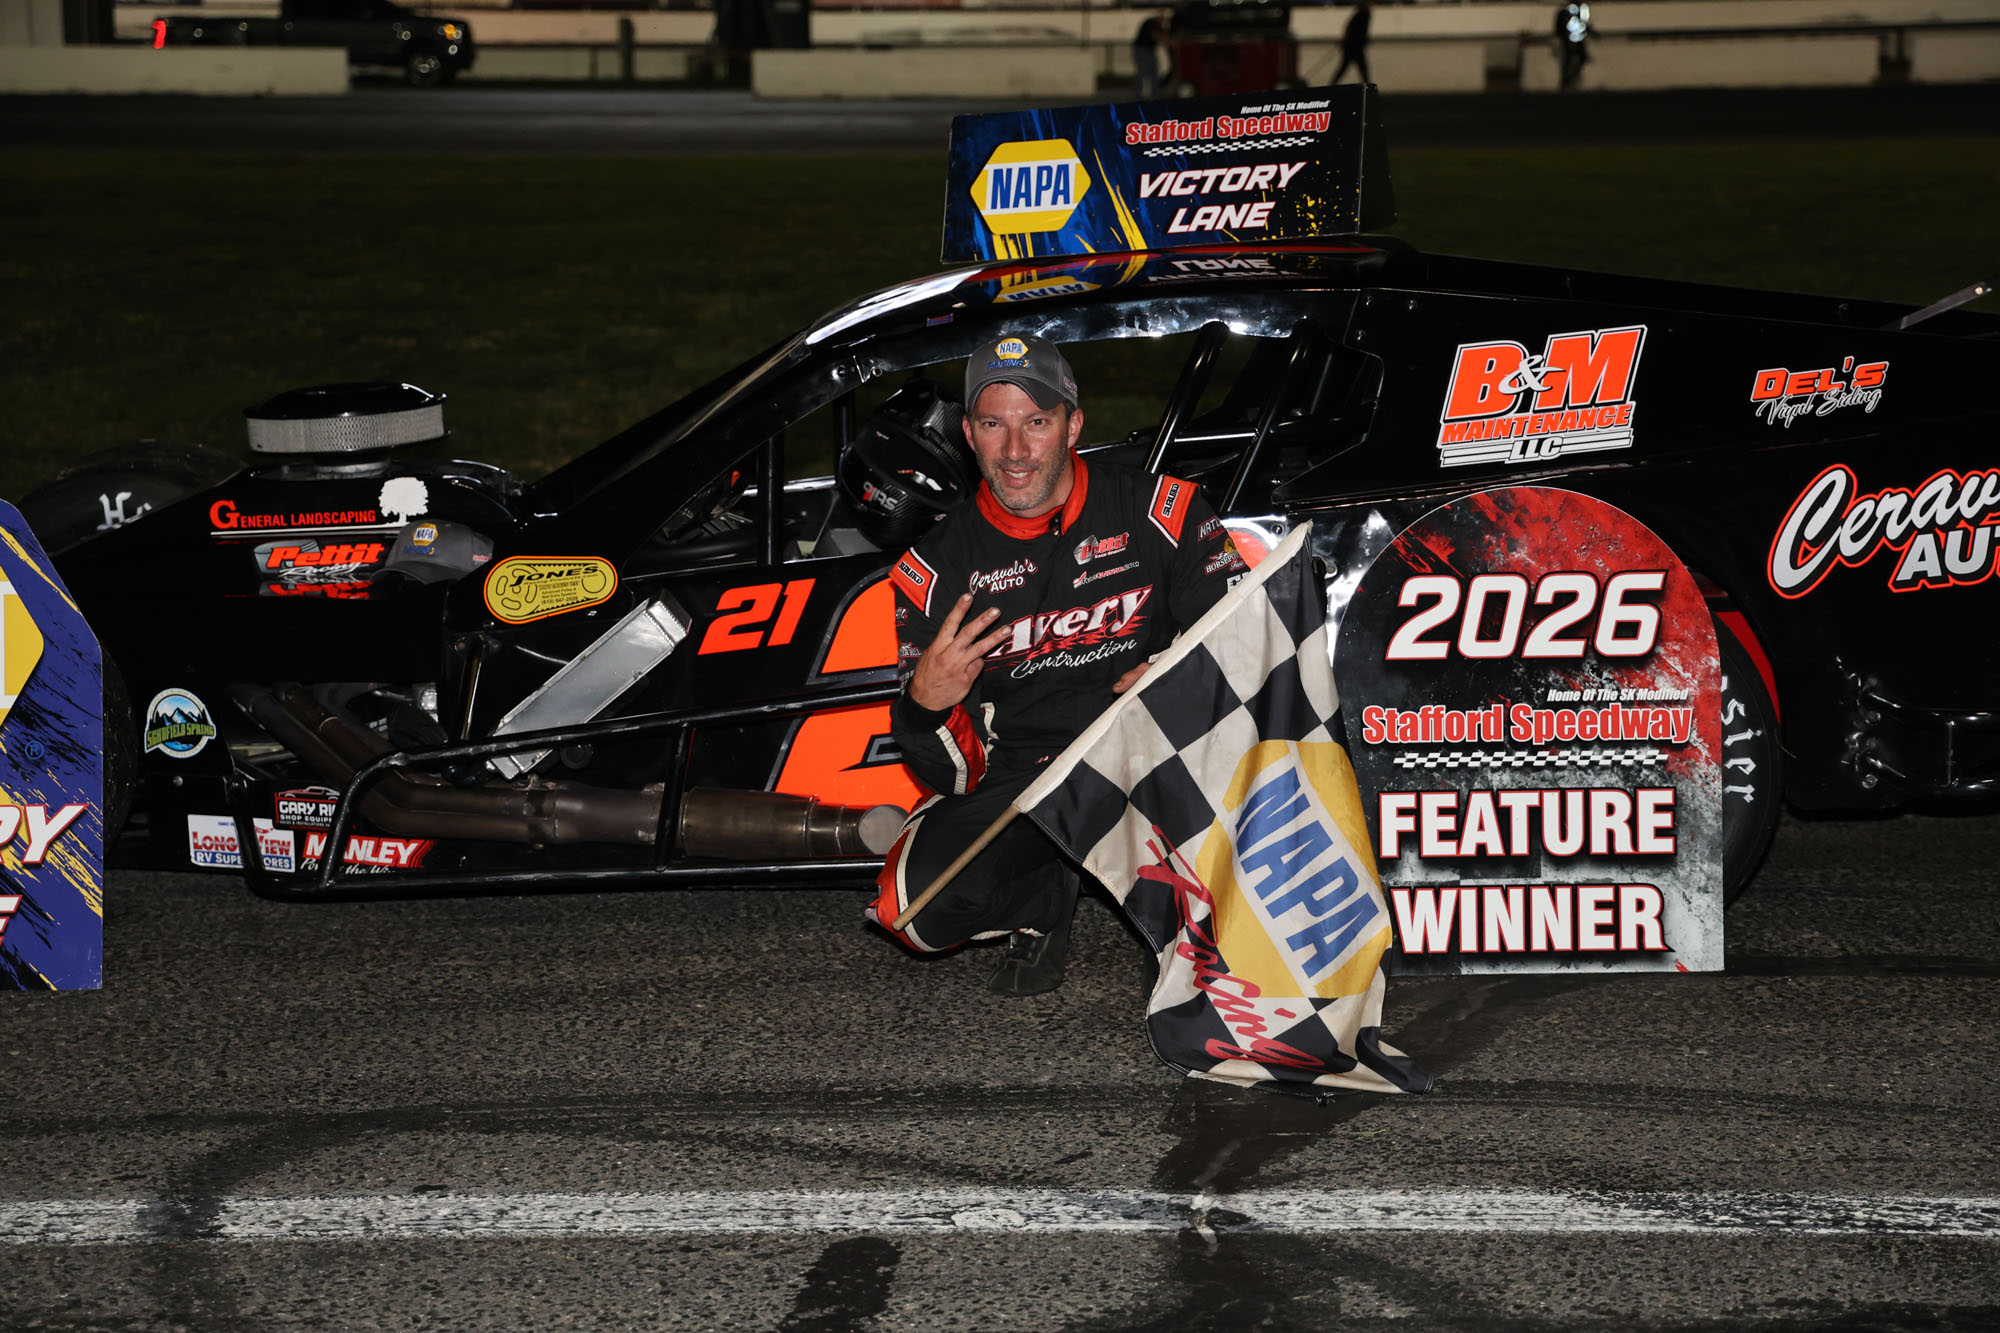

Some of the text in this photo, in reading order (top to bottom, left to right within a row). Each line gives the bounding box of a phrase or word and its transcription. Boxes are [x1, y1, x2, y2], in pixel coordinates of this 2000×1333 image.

[1241, 105, 1262, 114] Home
[1272, 103, 1285, 112] The
[1296, 100, 1330, 110] Modified
[1126, 111, 1331, 145] Stafford Speedway
[990, 162, 1071, 211] NAPA
[1139, 161, 1307, 198] VICTORY
[1168, 202, 1276, 234] LANE
[999, 343, 1023, 354] NAPA
[1440, 324, 1647, 423] B&M
[1750, 355, 1889, 402] DEL'S
[1437, 401, 1636, 449] MAINTENANCE
[1505, 436, 1564, 463] LLC
[209, 499, 377, 530] GENERAL LANDSCAPING
[1767, 463, 2000, 598] Cerav
[266, 543, 385, 568] Pettit
[1889, 520, 2000, 592] AU
[509, 566, 600, 588] JONES
[969, 558, 1037, 596] Ceravolo's
[990, 576, 1025, 593] AUTO
[697, 577, 816, 656] 21
[1385, 570, 1668, 661] 2026
[1547, 688, 1689, 702] Home Of The SK Modified
[1362, 702, 1693, 746] Stafford Speedway
[279, 800, 316, 816] GARY
[280, 814, 303, 822] SHOP
[1378, 788, 1676, 859] FEATURE
[196, 851, 213, 864] RV
[305, 834, 418, 864] MNLEY
[1235, 766, 1380, 979] NAPA
[1390, 884, 1670, 953] WINNER
[1137, 824, 1340, 1078] Racing
